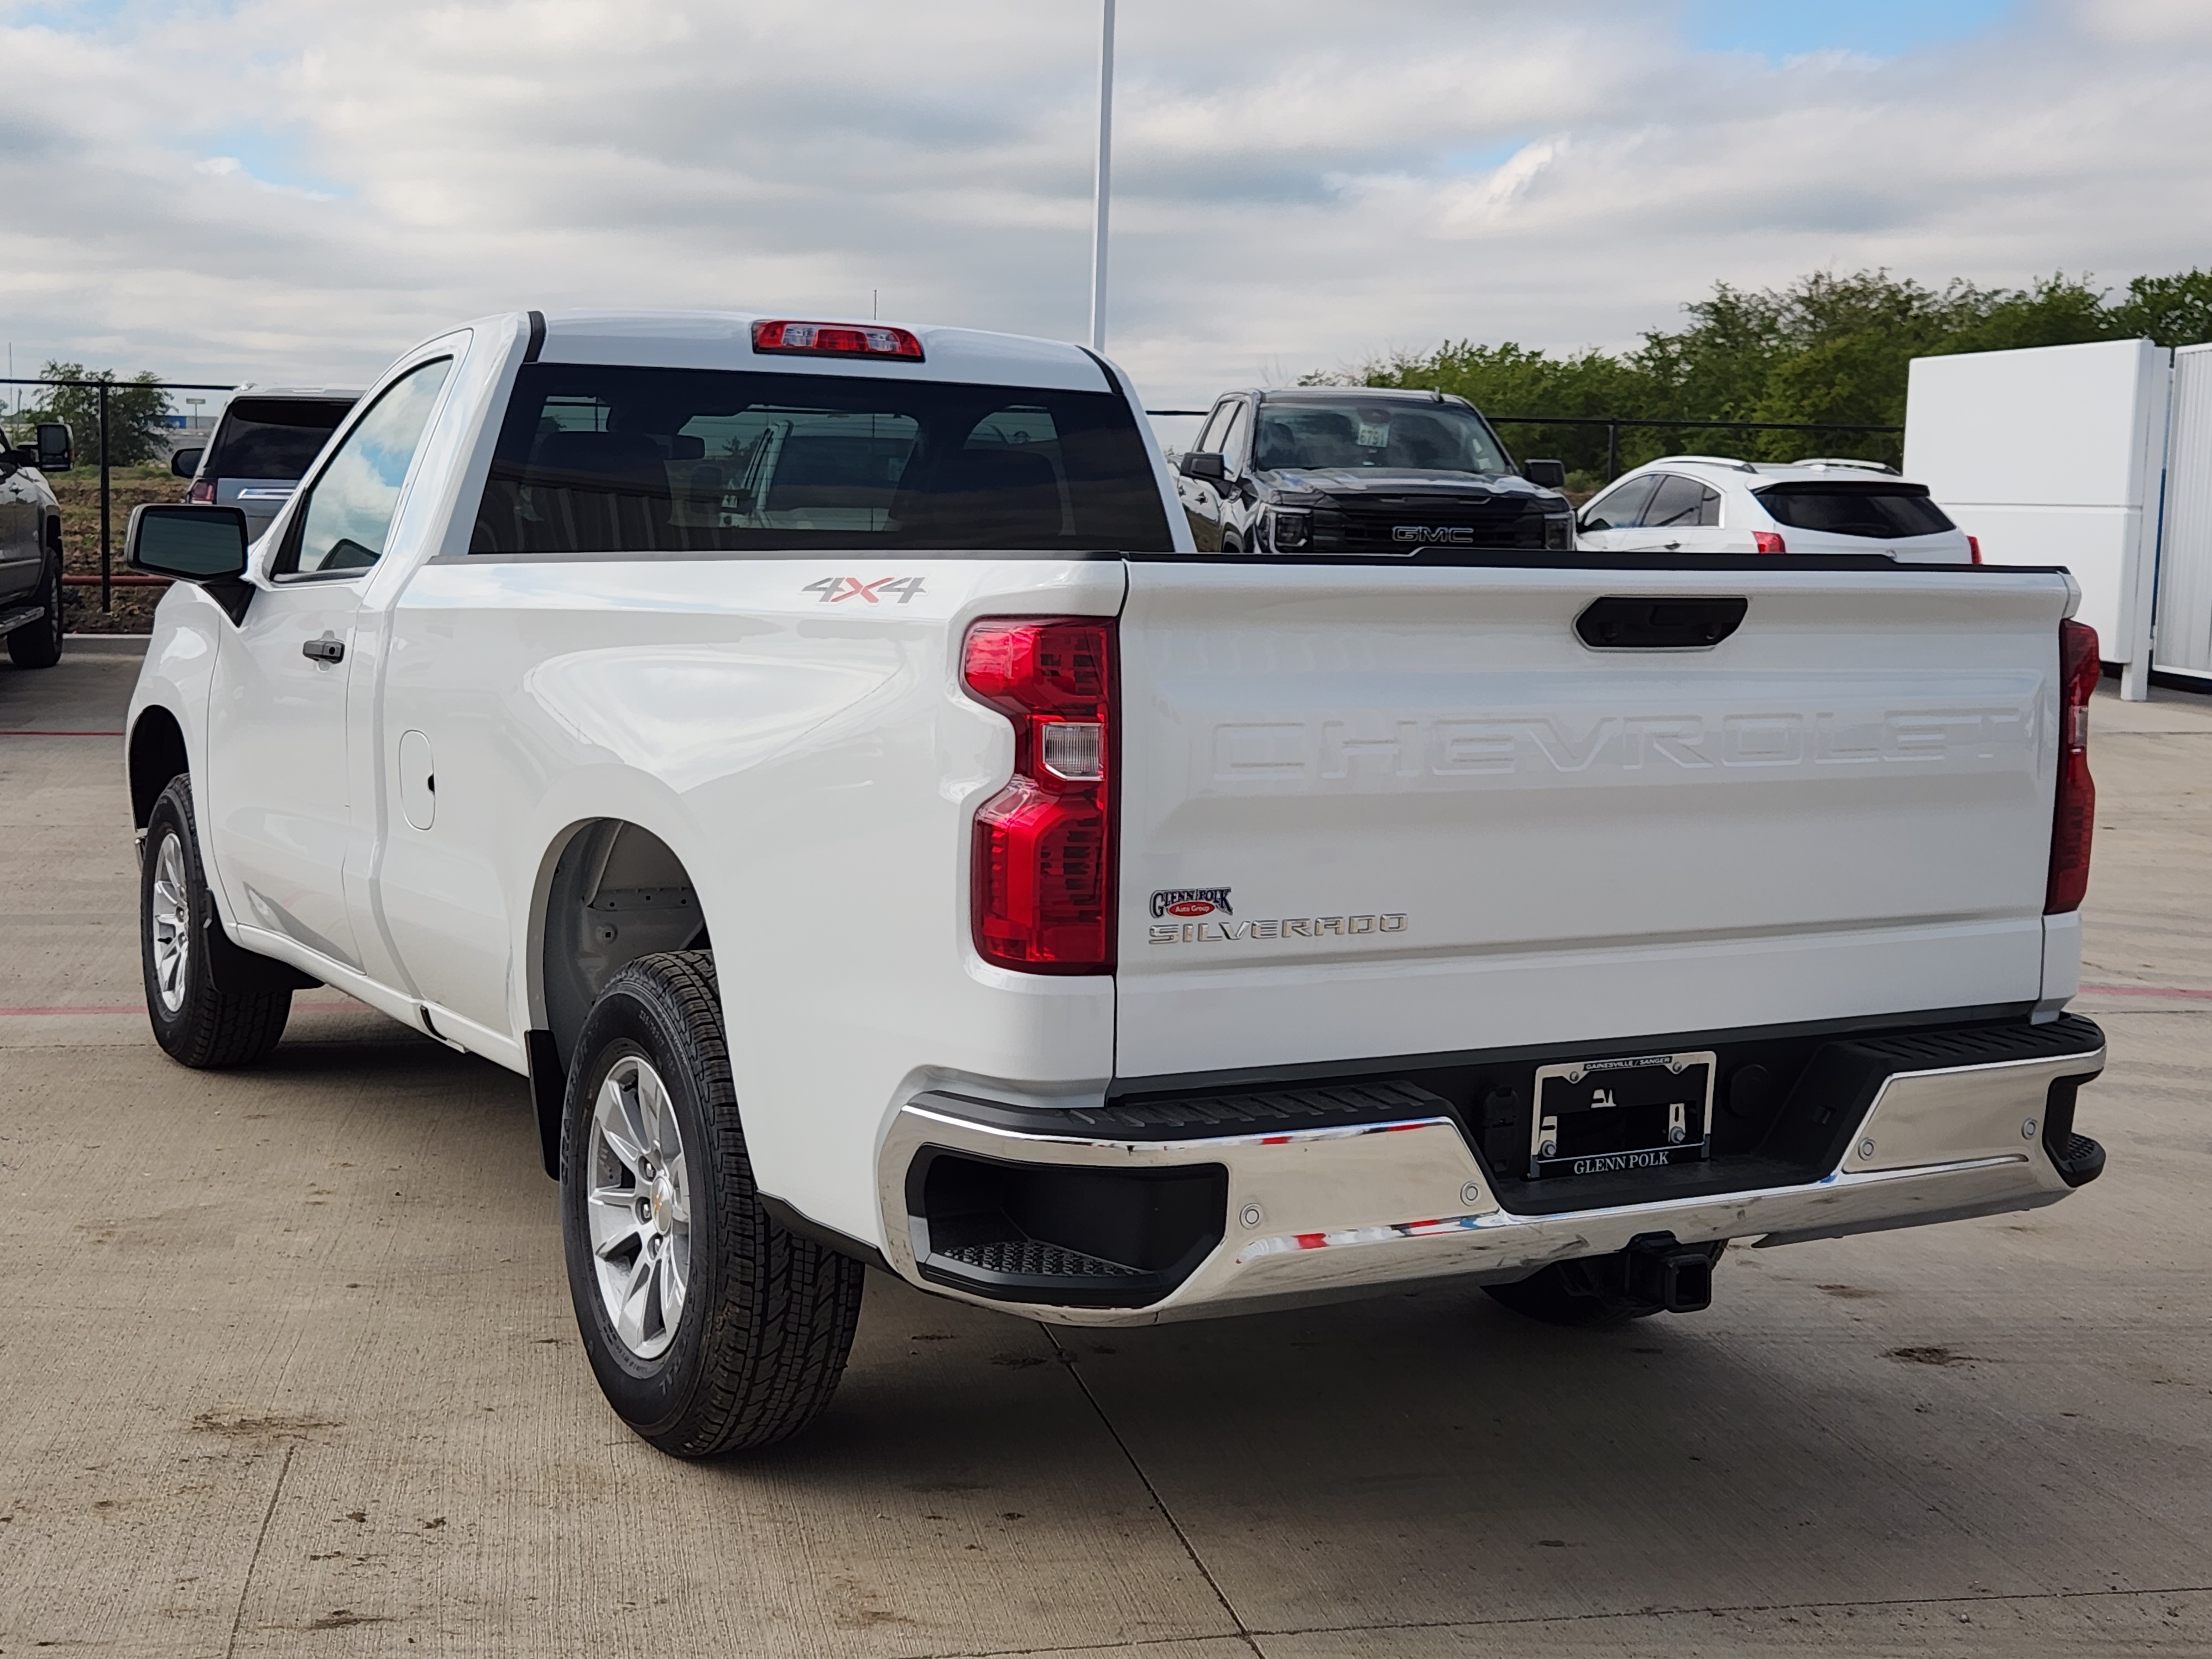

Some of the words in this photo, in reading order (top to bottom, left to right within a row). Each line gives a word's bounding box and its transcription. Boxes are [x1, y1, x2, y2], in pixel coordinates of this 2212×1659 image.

[1392, 526, 1474, 542] GMC
[1214, 707, 2020, 777] CHEVROLET
[1150, 888, 1198, 919] GLENN
[1198, 886, 1233, 915] POLK
[1149, 914, 1408, 945] SILVERADO
[1585, 1060, 1633, 1070] GAINESVILLE
[1574, 1156, 1626, 1174] GLENN
[1628, 1151, 1669, 1168] POLK
